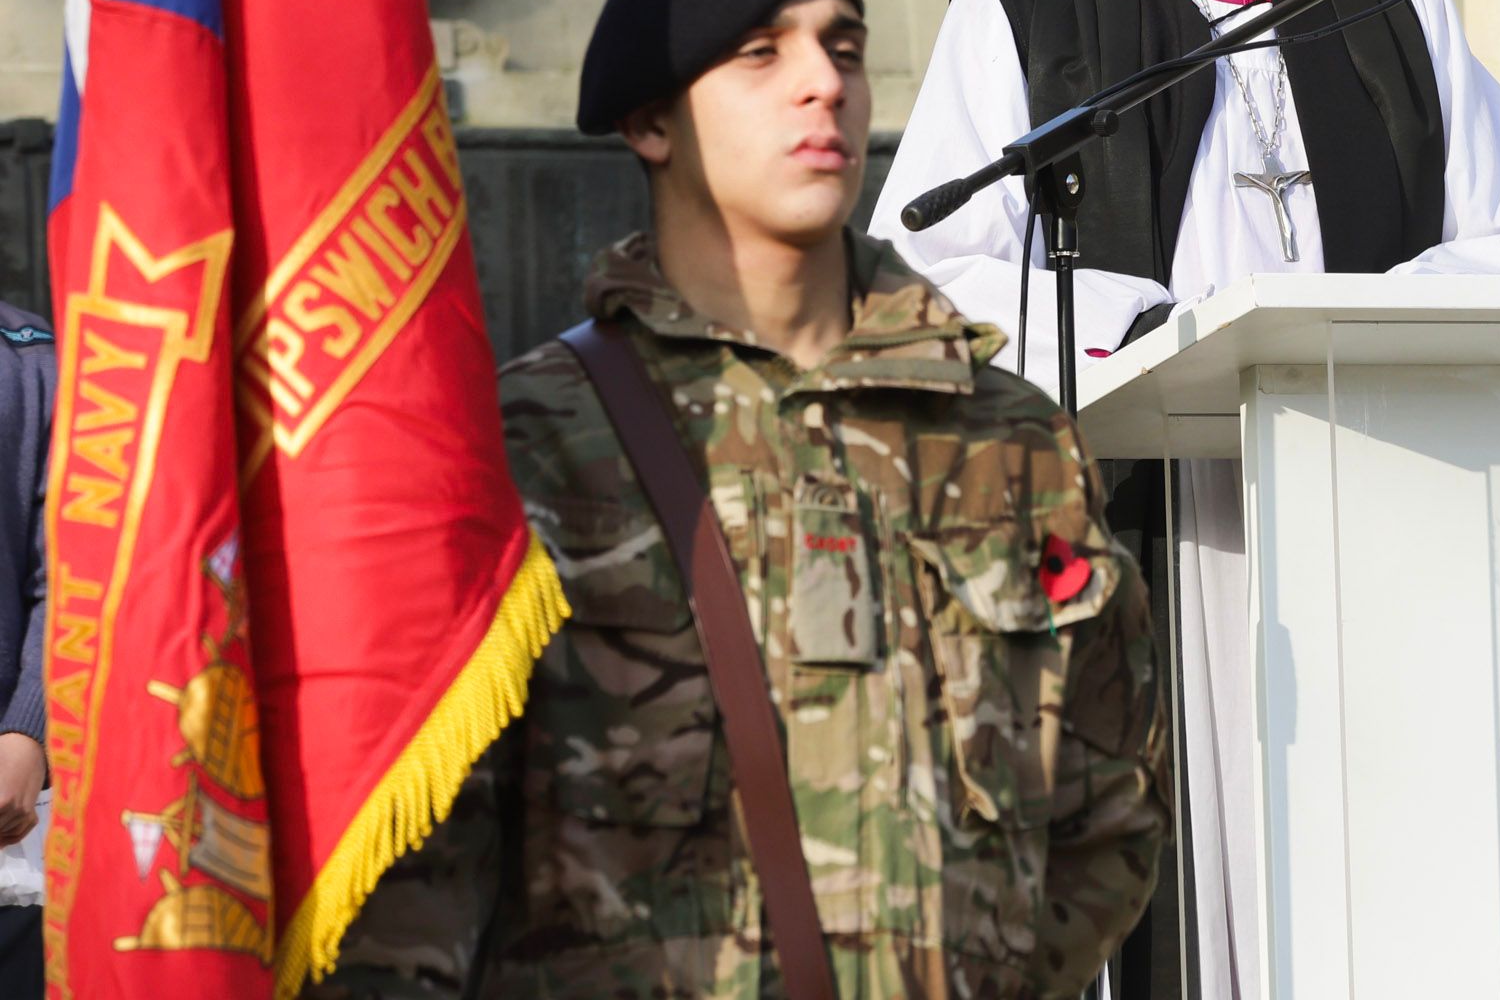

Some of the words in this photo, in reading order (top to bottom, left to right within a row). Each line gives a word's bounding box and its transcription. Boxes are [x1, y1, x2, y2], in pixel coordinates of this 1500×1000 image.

[244, 147, 453, 417] IPSWICH
[61, 329, 148, 528] NAVY
[46, 563, 104, 986] MERCHANT
